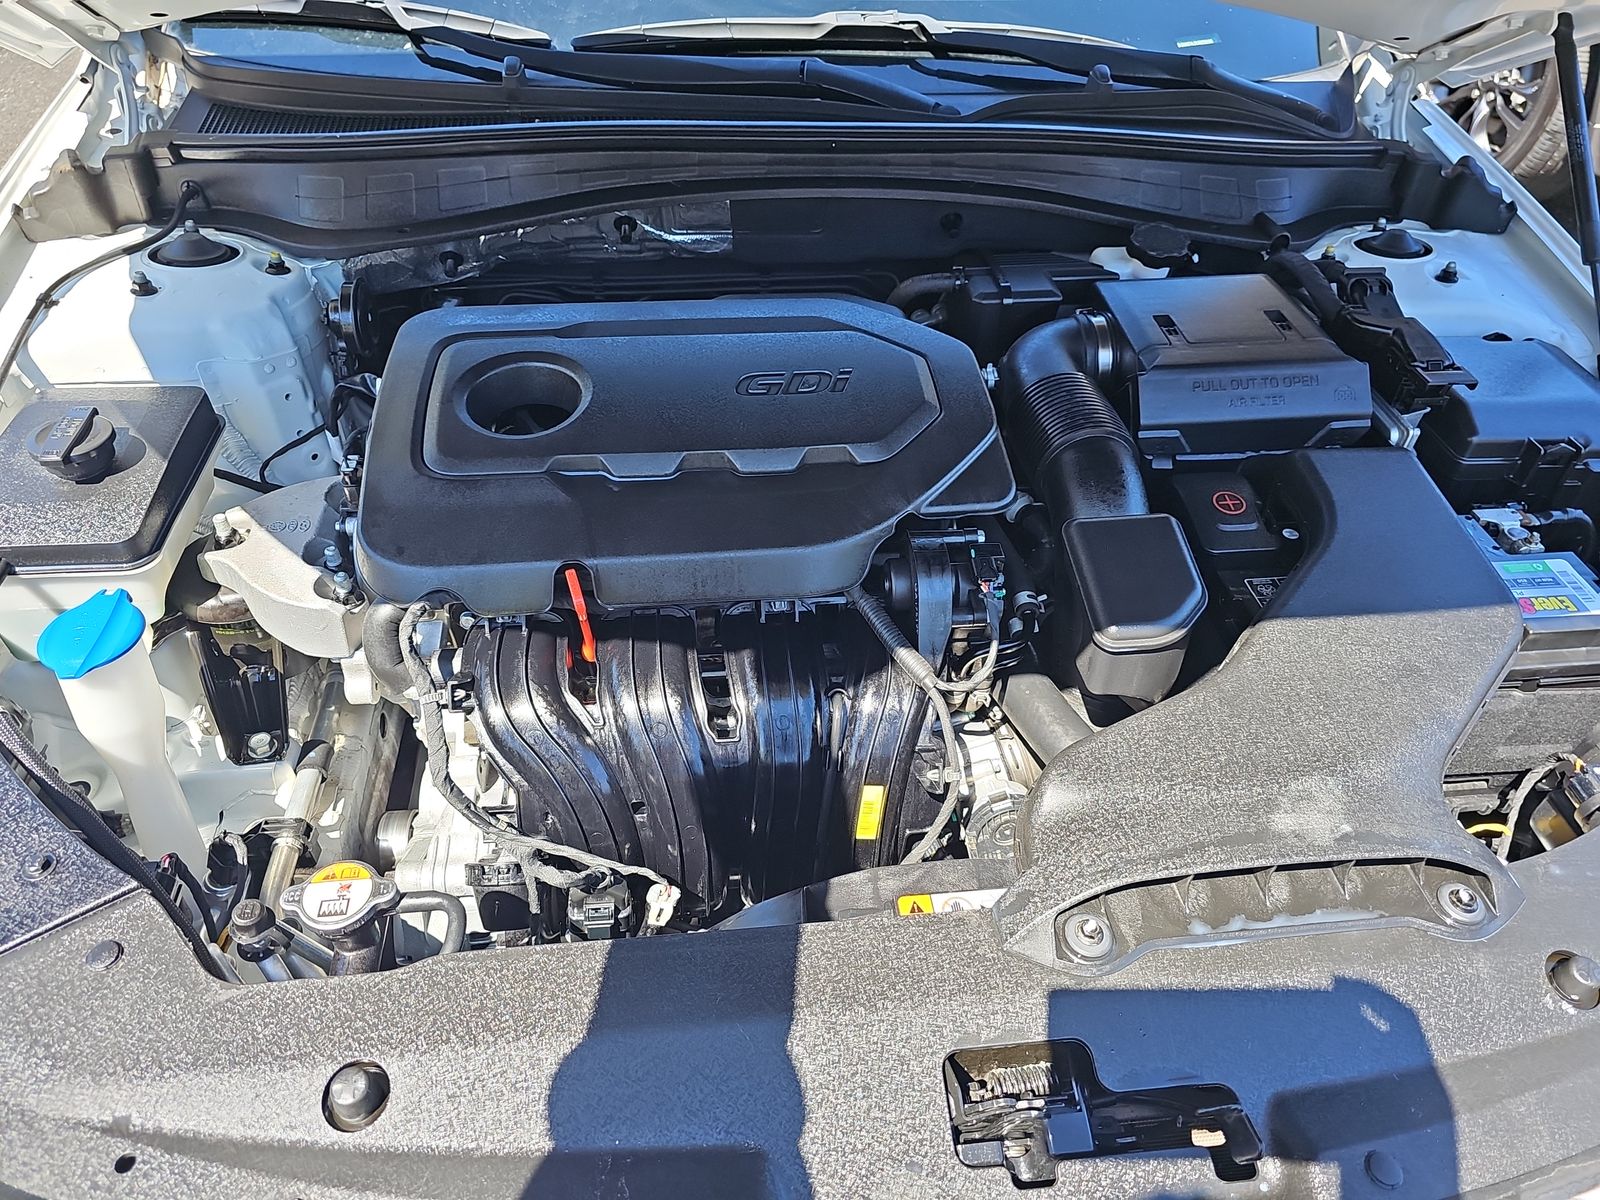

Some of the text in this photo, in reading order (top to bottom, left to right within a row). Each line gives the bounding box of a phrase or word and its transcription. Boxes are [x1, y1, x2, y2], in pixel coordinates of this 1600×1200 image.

[735, 368, 854, 397] GDi
[1192, 375, 1320, 392] PULL OUT TO OPEN
[1228, 395, 1286, 407] AIR FILTER
[1518, 595, 1578, 614] EverS
